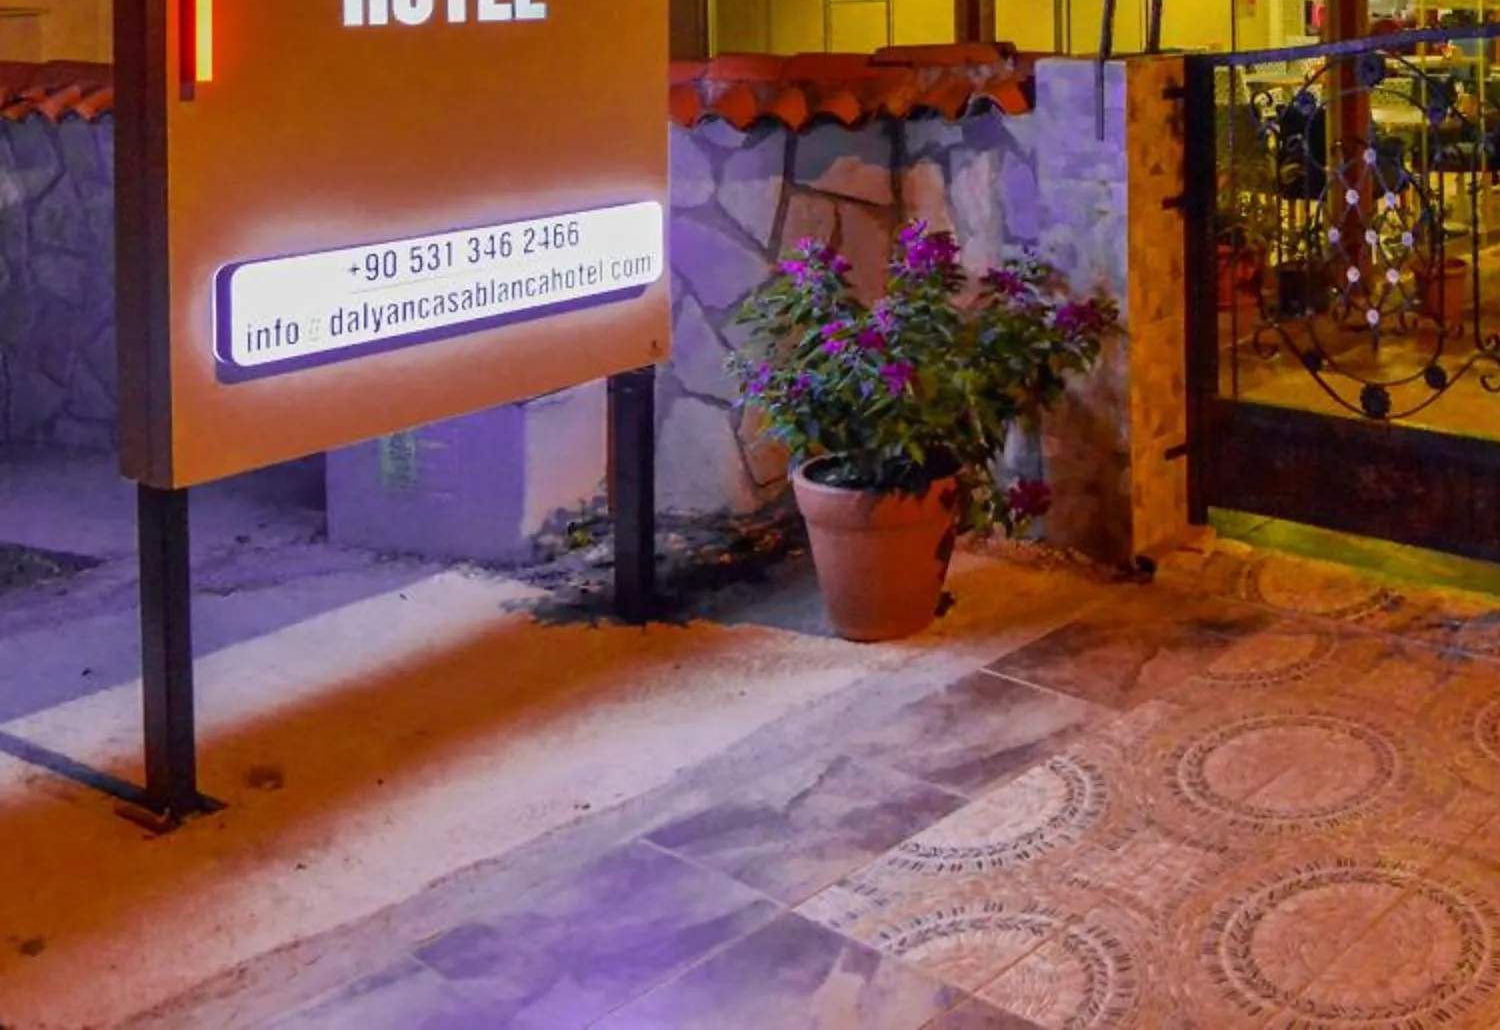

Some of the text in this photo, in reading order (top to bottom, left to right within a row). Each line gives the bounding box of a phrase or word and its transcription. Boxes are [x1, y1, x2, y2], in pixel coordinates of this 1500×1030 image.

[350, 221, 580, 282] +90 531 346 2466
